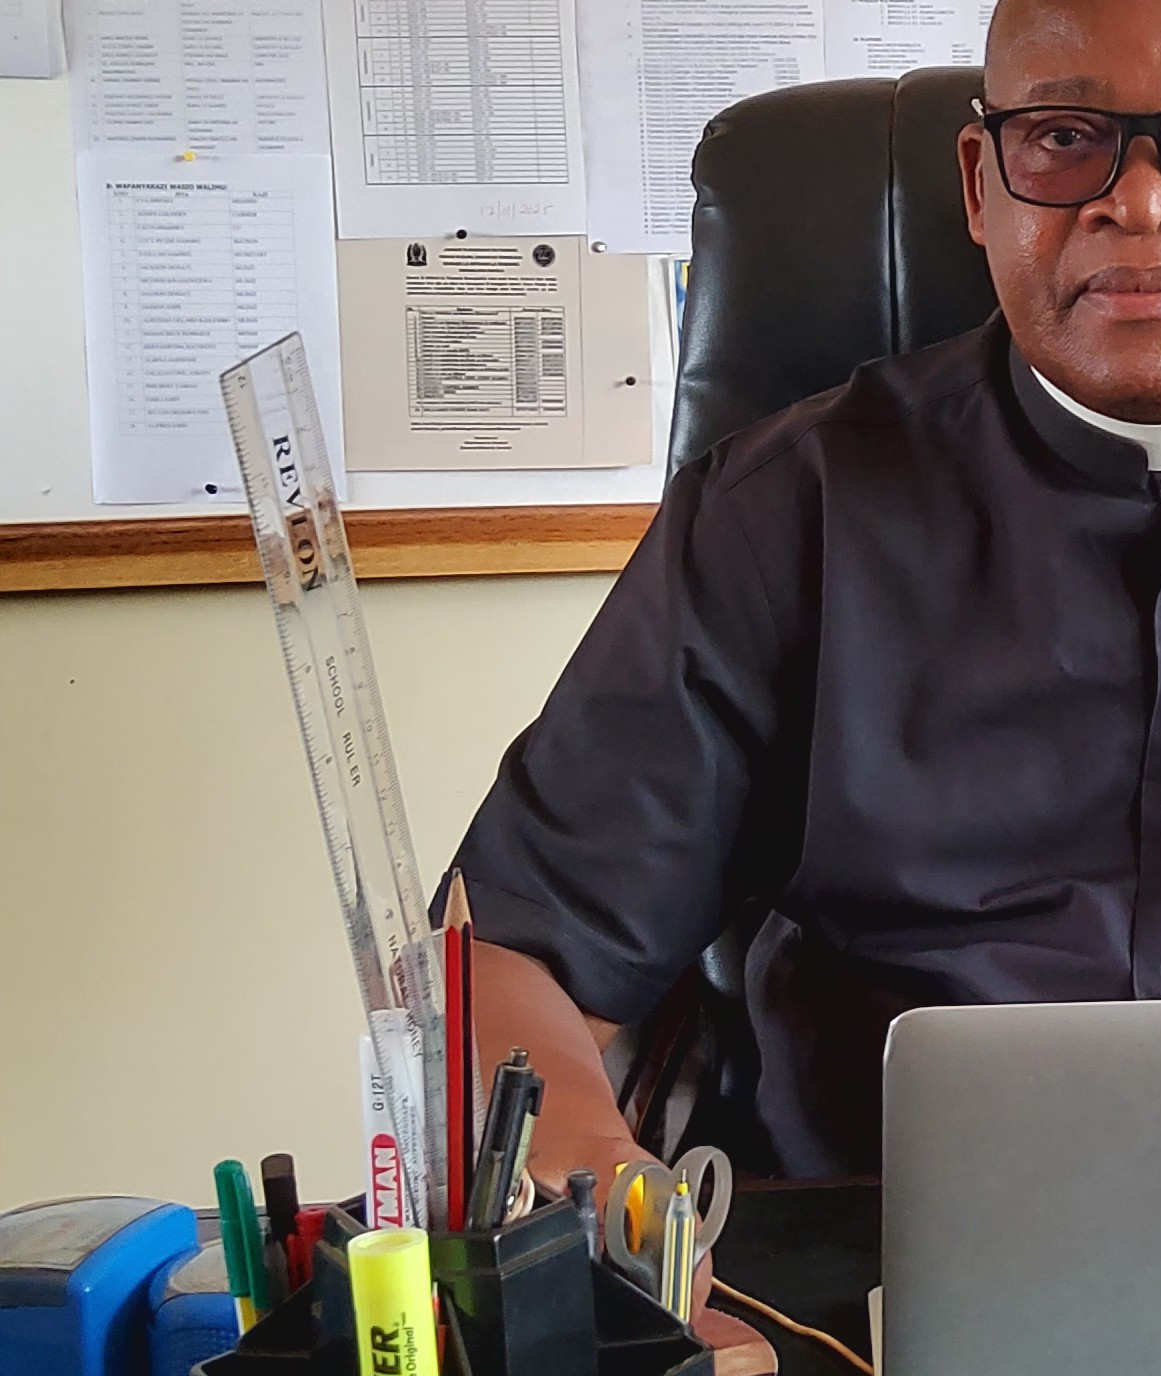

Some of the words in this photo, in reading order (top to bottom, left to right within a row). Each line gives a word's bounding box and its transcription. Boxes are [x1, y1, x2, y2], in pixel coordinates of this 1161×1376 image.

[272, 435, 323, 592] REVLON
[325, 655, 346, 718] SCHOOL
[342, 731, 361, 788] RULER
[405, 1327, 418, 1372] Original
